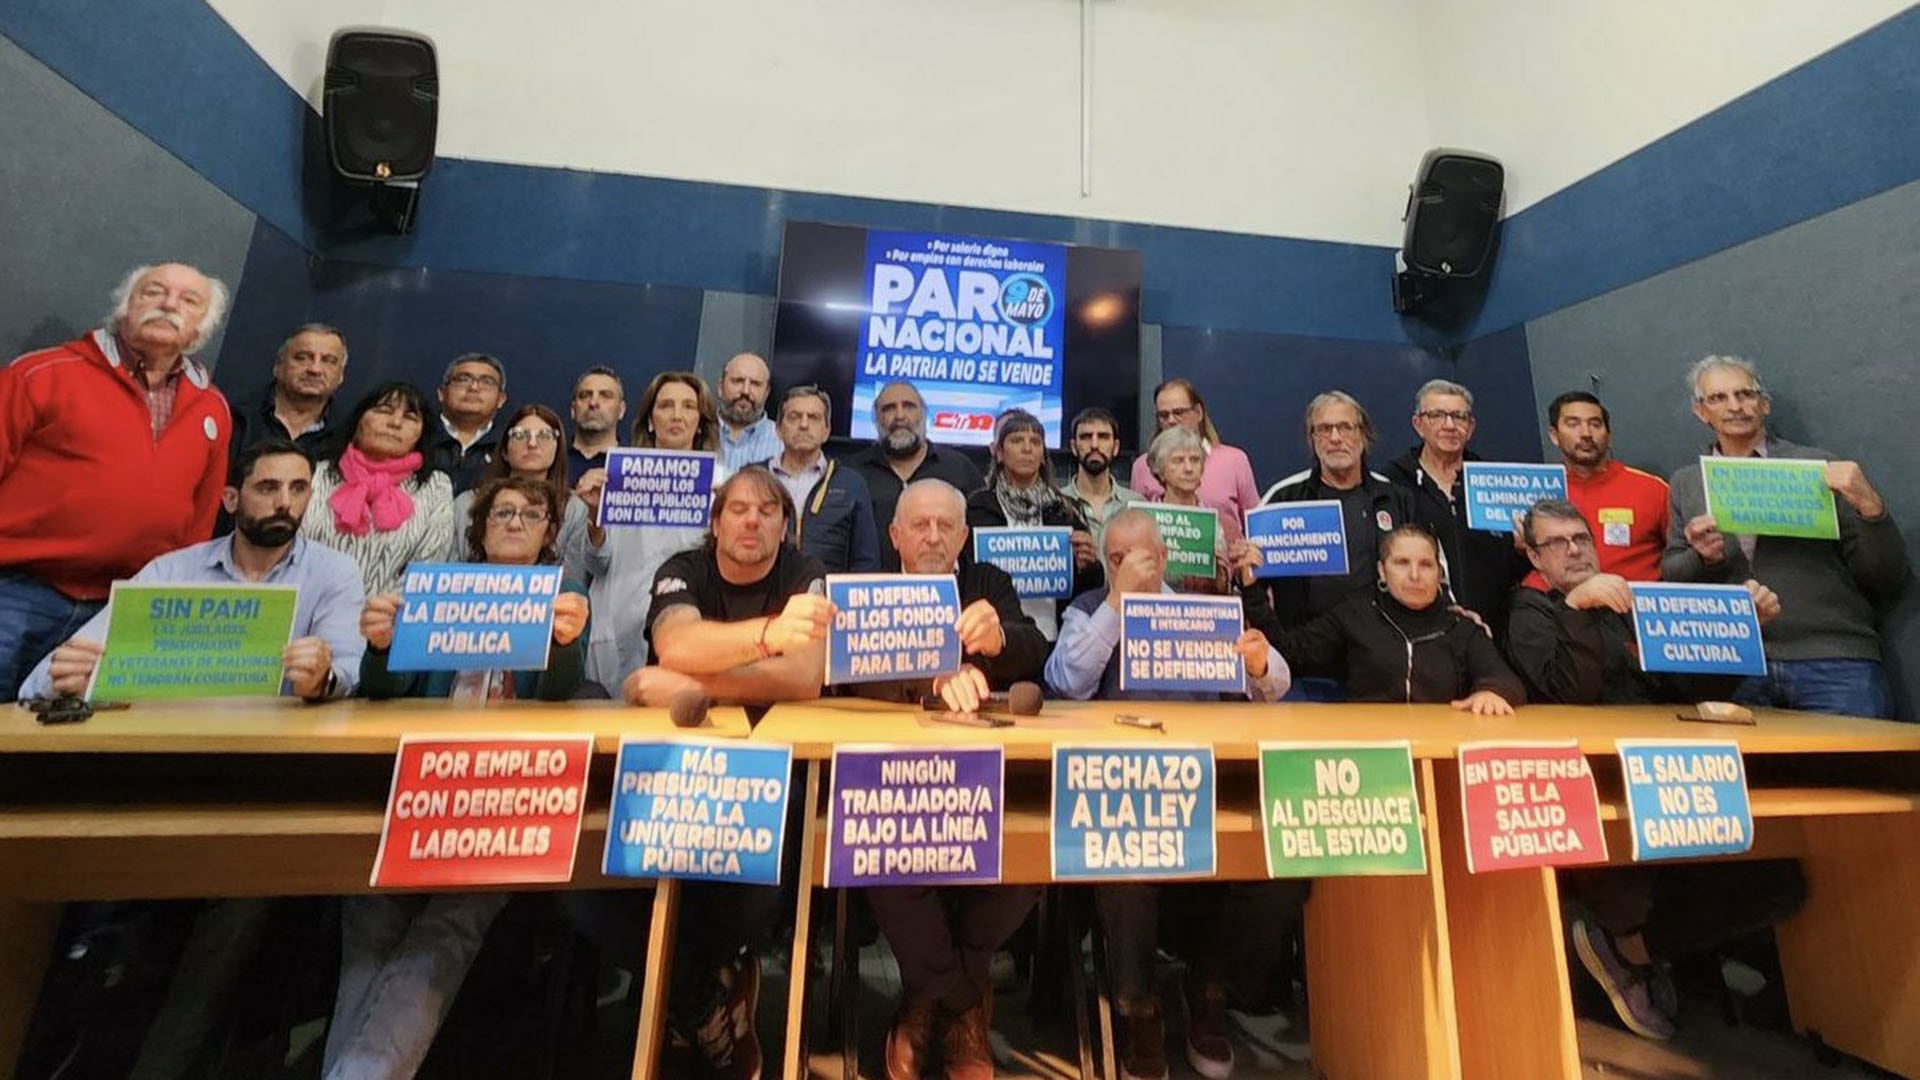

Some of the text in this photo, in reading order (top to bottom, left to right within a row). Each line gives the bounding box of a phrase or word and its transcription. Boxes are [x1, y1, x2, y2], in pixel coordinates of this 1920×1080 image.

[892, 249, 1045, 273] Por empleo con derechos laborales
[934, 240, 1009, 258] Por salario digno
[1005, 281, 1046, 301] 9 DE
[1006, 301, 1045, 319] MAYO
[869, 316, 1053, 359] NACIONAL
[865, 352, 1053, 386] LA PATRIA NO SE VENDE
[621, 456, 701, 478] PARAMOS
[623, 477, 694, 493] PORQUE LOS
[1470, 474, 1562, 490] RECHAZO A LA
[606, 491, 707, 509] MEDIOS PÚBLICOS
[607, 508, 703, 524] SON DEL PUEBLO
[1156, 511, 1192, 527] NO AL
[1282, 517, 1305, 530] POR
[1486, 507, 1510, 520] DEL
[1731, 510, 1815, 527] NATURALES
[988, 534, 1060, 553] CONTRA LA
[1160, 525, 1201, 540] RIFAZO
[1166, 537, 1181, 550] AL
[1266, 549, 1328, 564] EDUCATIVO
[406, 572, 556, 595] EN DEFENSA DE
[150, 597, 261, 620] SIN PAMI
[848, 586, 941, 607] EN DEFENSA
[1636, 595, 1752, 616] EN DEFENSA DE
[402, 599, 547, 624] LA EDUCACIÓN
[836, 605, 955, 631] DE LOS FONDOS
[1126, 602, 1239, 620] AEROLÍNEAS ARGENTINAS
[1159, 618, 1216, 632] INTERCARGO
[1645, 620, 1750, 639] LA ACTIVIDAD
[427, 627, 512, 654] PÚBLICA
[847, 629, 945, 653] NACIONALES
[1127, 638, 1150, 659] NO
[1153, 639, 1172, 659] SE
[1664, 643, 1742, 663] CULTURAL
[851, 651, 940, 676] PARA EL IPS
[1130, 660, 1236, 680] SE DEFIENDEN
[420, 749, 568, 780] POR EMPLEO
[681, 746, 728, 776] MÁS
[881, 755, 957, 786] NINGÚN
[1067, 755, 1203, 791] RECHAZO
[1465, 756, 1592, 786] EN DEFENSA
[1627, 754, 1738, 785] EL SALARIO
[621, 771, 783, 804] PRESUPUESTO
[1314, 758, 1361, 797] NO
[395, 786, 578, 819] CON DERECHOS
[841, 785, 993, 816] TRABAJADOR/A
[1495, 781, 1561, 806] DE LA
[1658, 784, 1719, 816] NO ES
[651, 796, 746, 827] PARA LA
[1071, 792, 1198, 829] A LA LEY
[1272, 797, 1413, 828] AL DESGUACE
[1495, 804, 1566, 831] SALUD
[619, 819, 773, 854] UNIVERSIDAD
[843, 813, 988, 846] BAJO LA LÍNEA
[1643, 815, 1744, 849] GANANCIA
[408, 825, 552, 860] LABORALES
[1084, 830, 1185, 869] BASES!
[1281, 826, 1408, 859] DEL ESTADO
[1490, 830, 1584, 859] PÚBLICA
[642, 843, 741, 875] PÚBLICA
[853, 845, 977, 876] DE POBREZA
